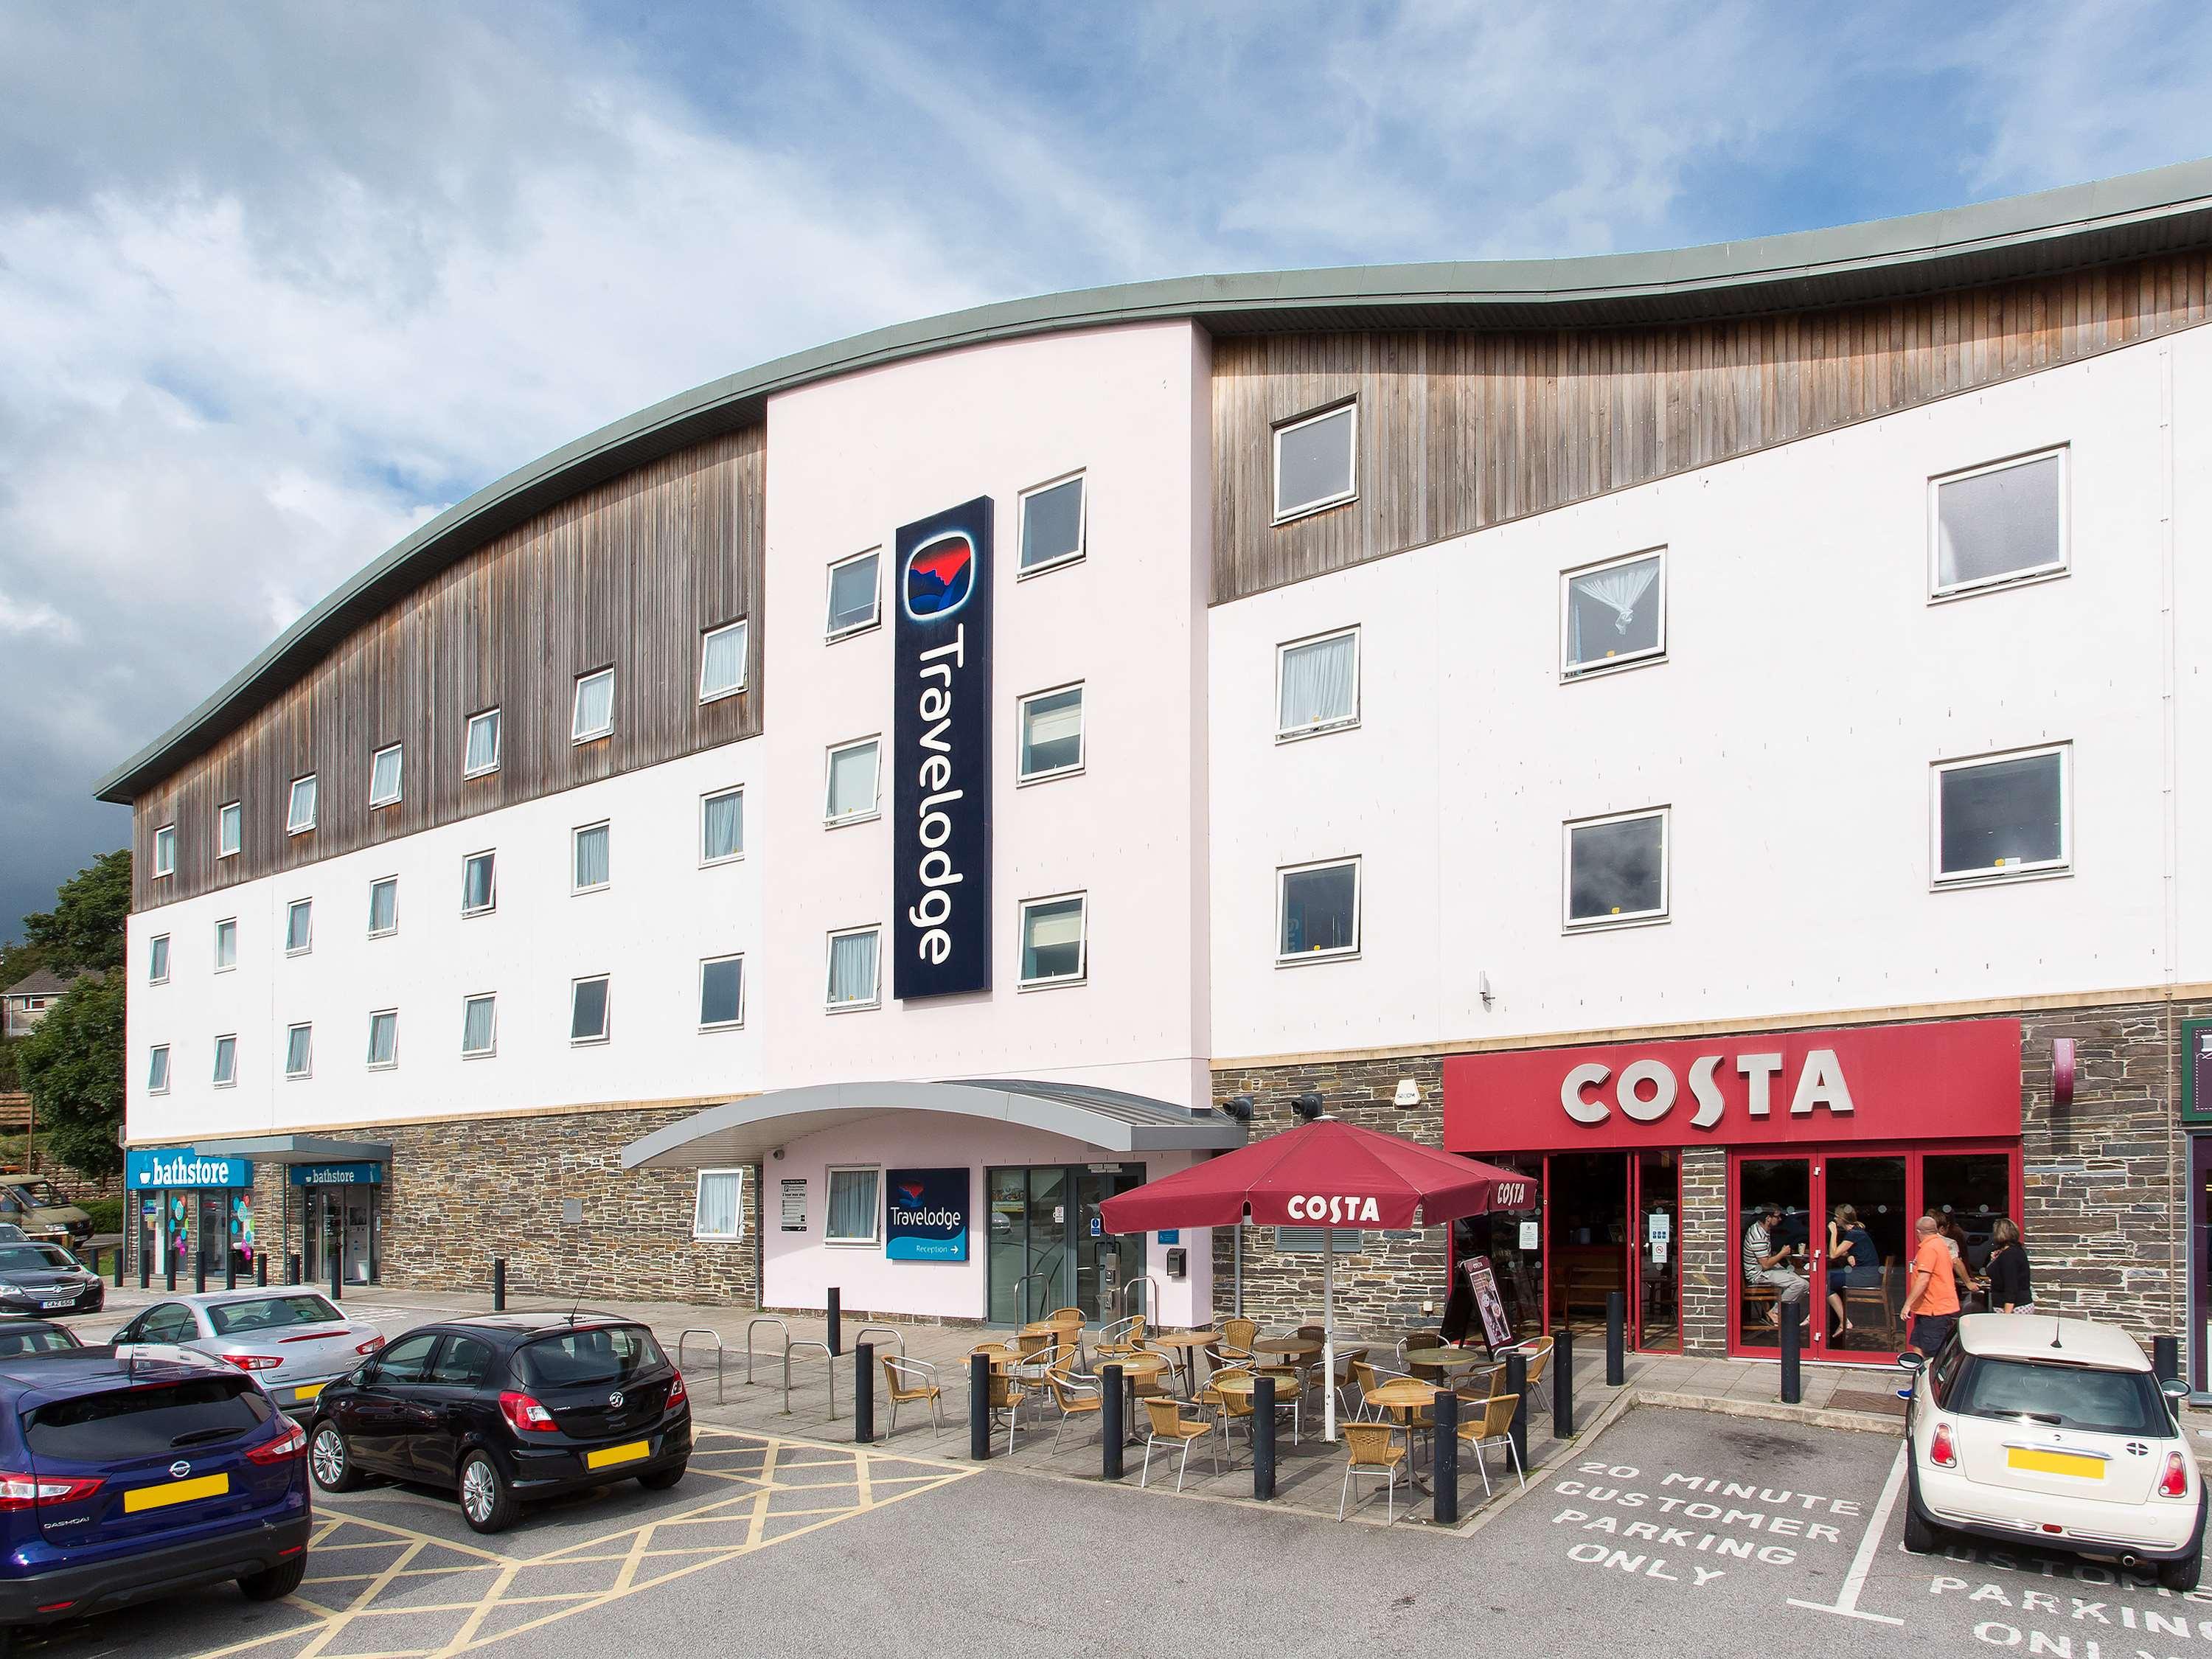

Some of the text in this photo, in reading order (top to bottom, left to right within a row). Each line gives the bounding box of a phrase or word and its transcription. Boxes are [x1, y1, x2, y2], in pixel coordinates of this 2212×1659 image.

[908, 622, 964, 965] Travelodge
[1560, 1048, 1854, 1127] COSTA
[152, 1155, 229, 1186] bathstore
[313, 1169, 355, 1183] bathstore
[1287, 1194, 1380, 1224] COSTA
[1497, 1183, 1525, 1207] COSTA
[890, 1206, 961, 1231] Travelodge
[917, 1245, 947, 1253] Reception
[1577, 1461, 1864, 1517] 20 MINUTE
[1554, 1481, 1841, 1543] CUSTOMER
[1551, 1509, 1798, 1565] PARKING
[1567, 1543, 1726, 1586] ONLY
[1899, 1541, 2212, 1604] USTOM
